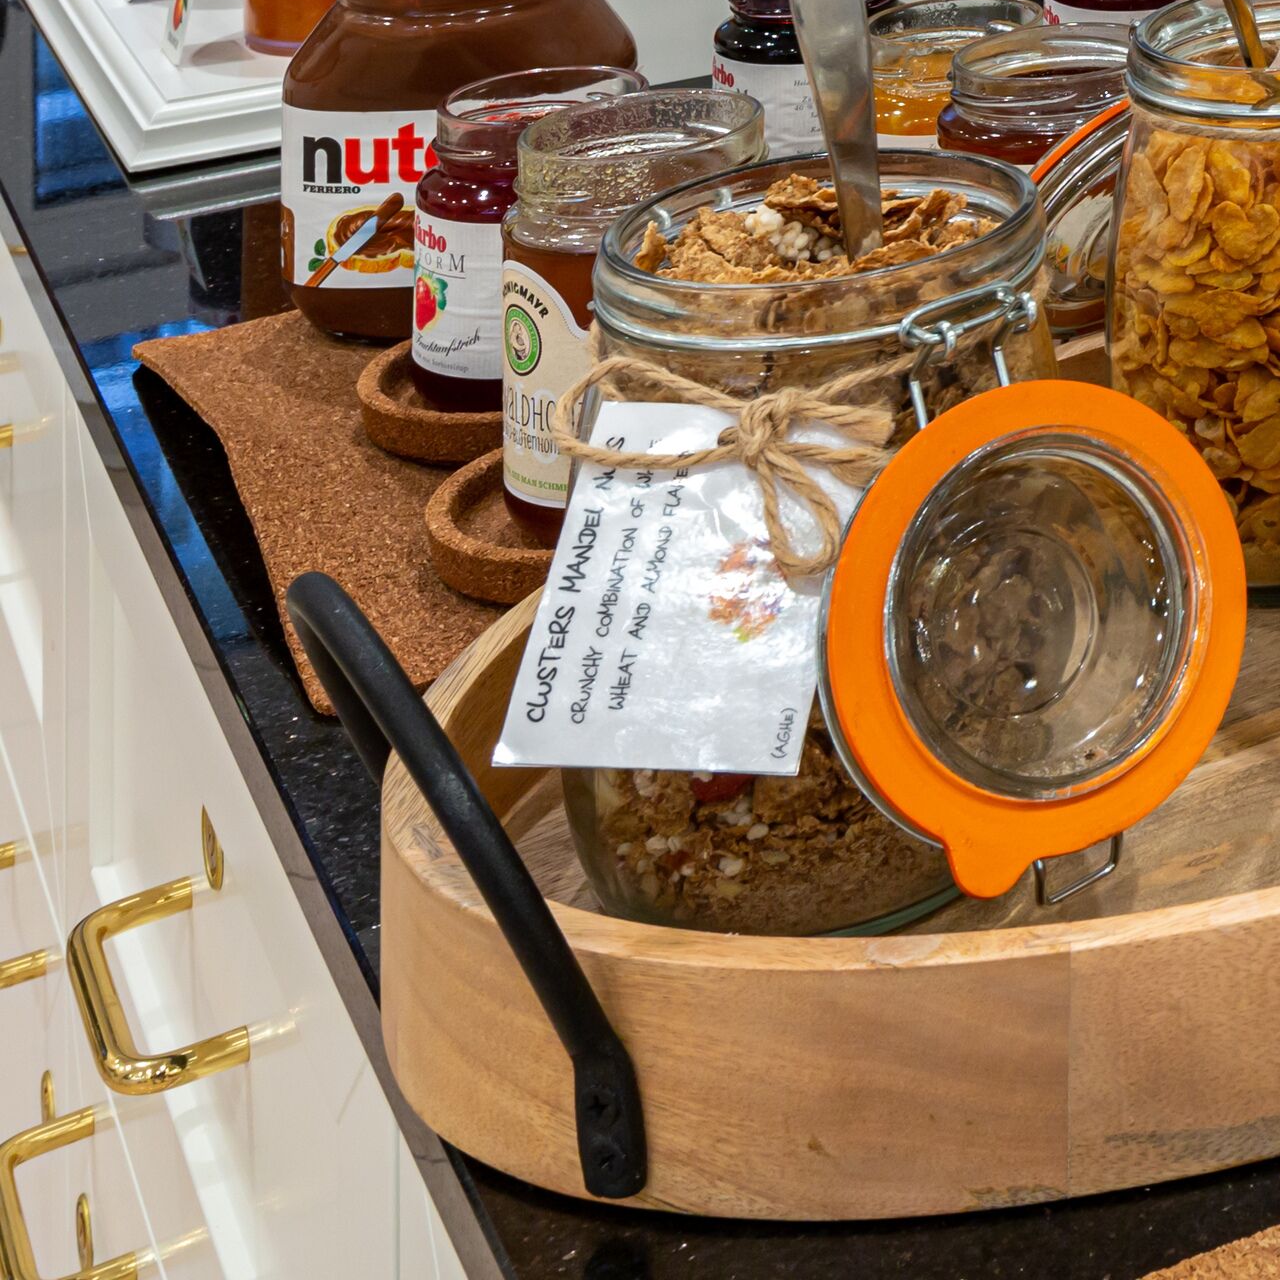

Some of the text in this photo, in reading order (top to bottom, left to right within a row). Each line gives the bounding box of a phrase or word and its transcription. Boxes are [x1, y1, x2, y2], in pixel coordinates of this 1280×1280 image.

[302, 122, 440, 185] nut
[302, 184, 362, 195] FERRERO
[414, 214, 447, 253] arbo
[526, 605, 576, 723] CLUSTERS
[558, 507, 604, 593] MANDEL
[570, 497, 645, 724] CRUNCHY COMBINATION OF
[608, 647, 638, 710] WHEAT
[628, 602, 651, 641] AND
[640, 526, 673, 594] ALMOND
